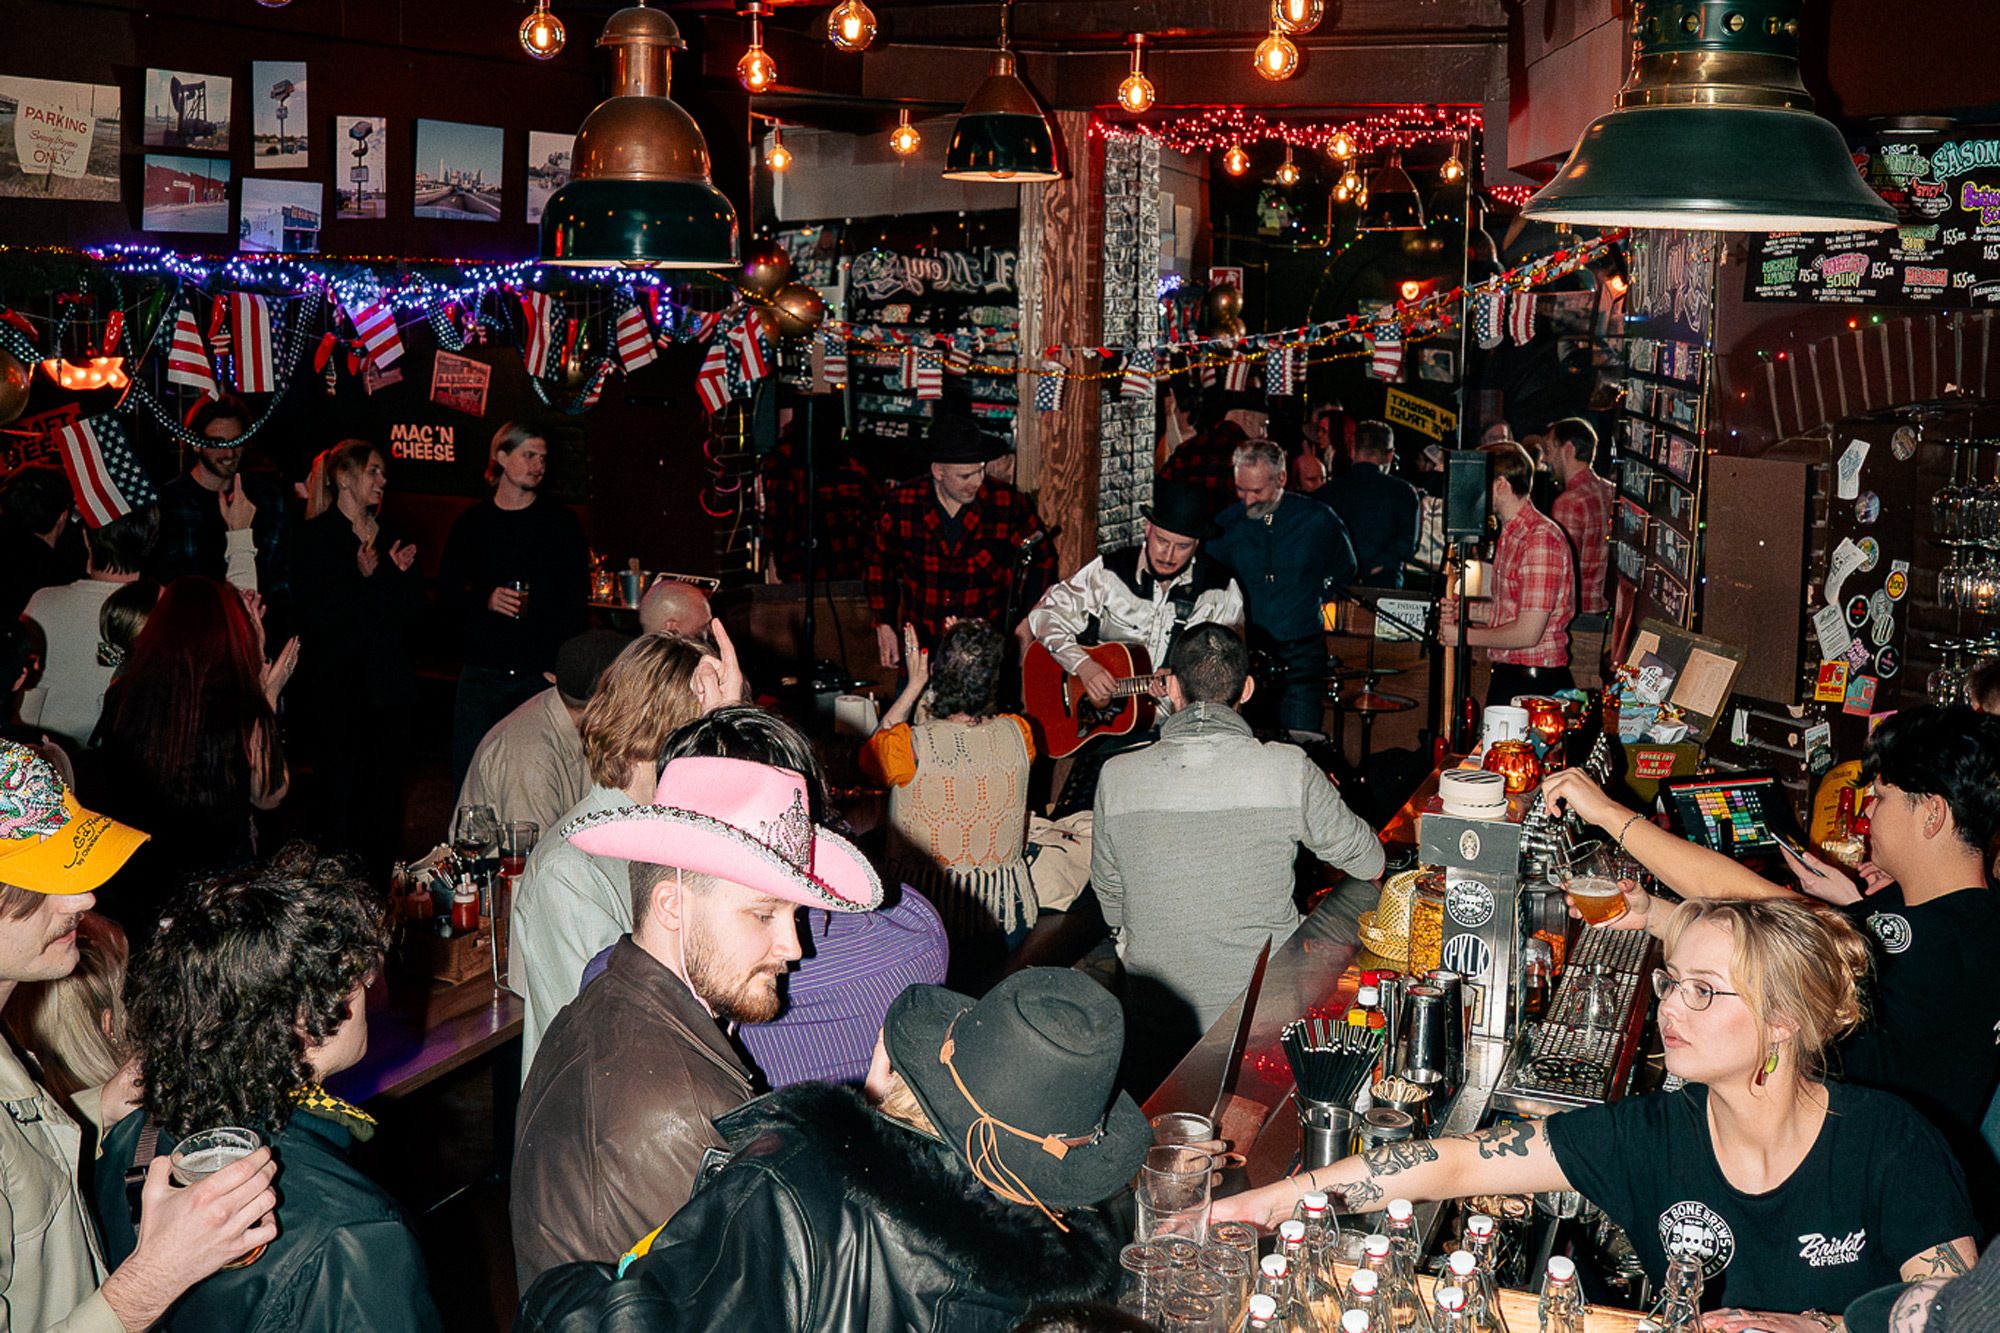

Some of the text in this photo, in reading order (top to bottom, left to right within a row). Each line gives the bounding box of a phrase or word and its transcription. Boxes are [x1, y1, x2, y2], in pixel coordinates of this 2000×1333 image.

[25, 106, 87, 133] PARKING
[33, 150, 72, 166] ONLY
[1933, 142, 2000, 176] SÄSON
[391, 424, 433, 443] MAC
[391, 441, 456, 462] CHEESE
[1449, 935, 1486, 976] PKLK
[1671, 1203, 1703, 1220] BONE
[1702, 1209, 1732, 1247] BREWS
[1704, 1253, 1727, 1275] BEER
